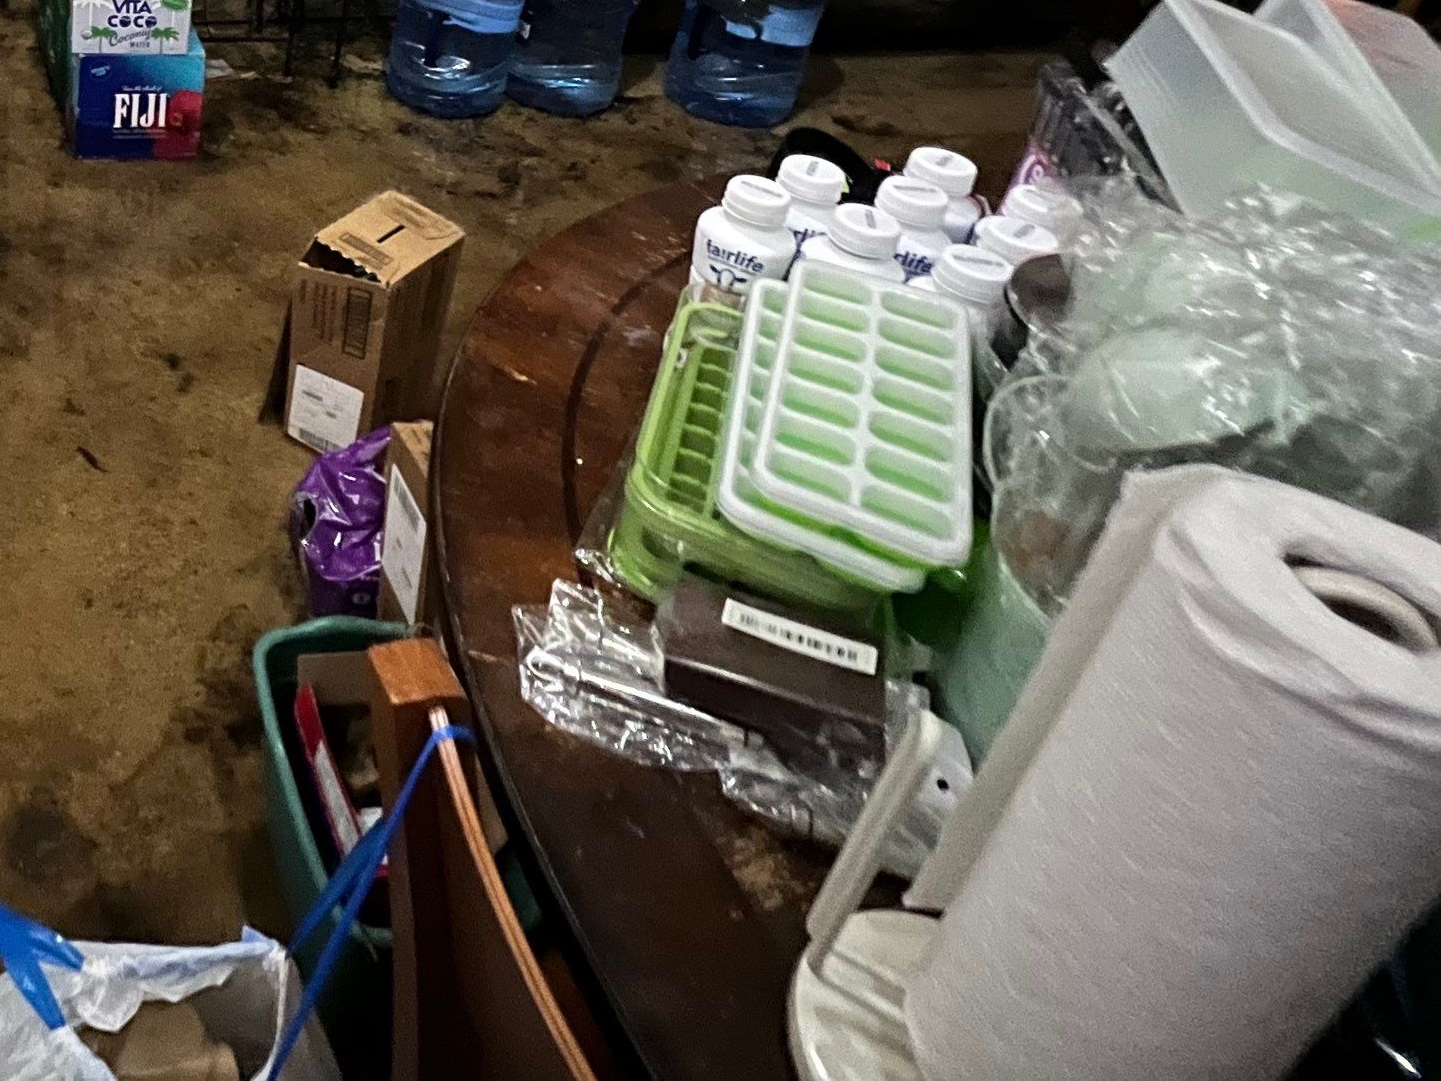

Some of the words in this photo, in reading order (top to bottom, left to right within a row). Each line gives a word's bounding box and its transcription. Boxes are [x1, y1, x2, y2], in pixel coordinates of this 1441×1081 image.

[107, 15, 158, 29] COCO
[112, 92, 168, 129] FIJI
[706, 238, 765, 273] fairlife
